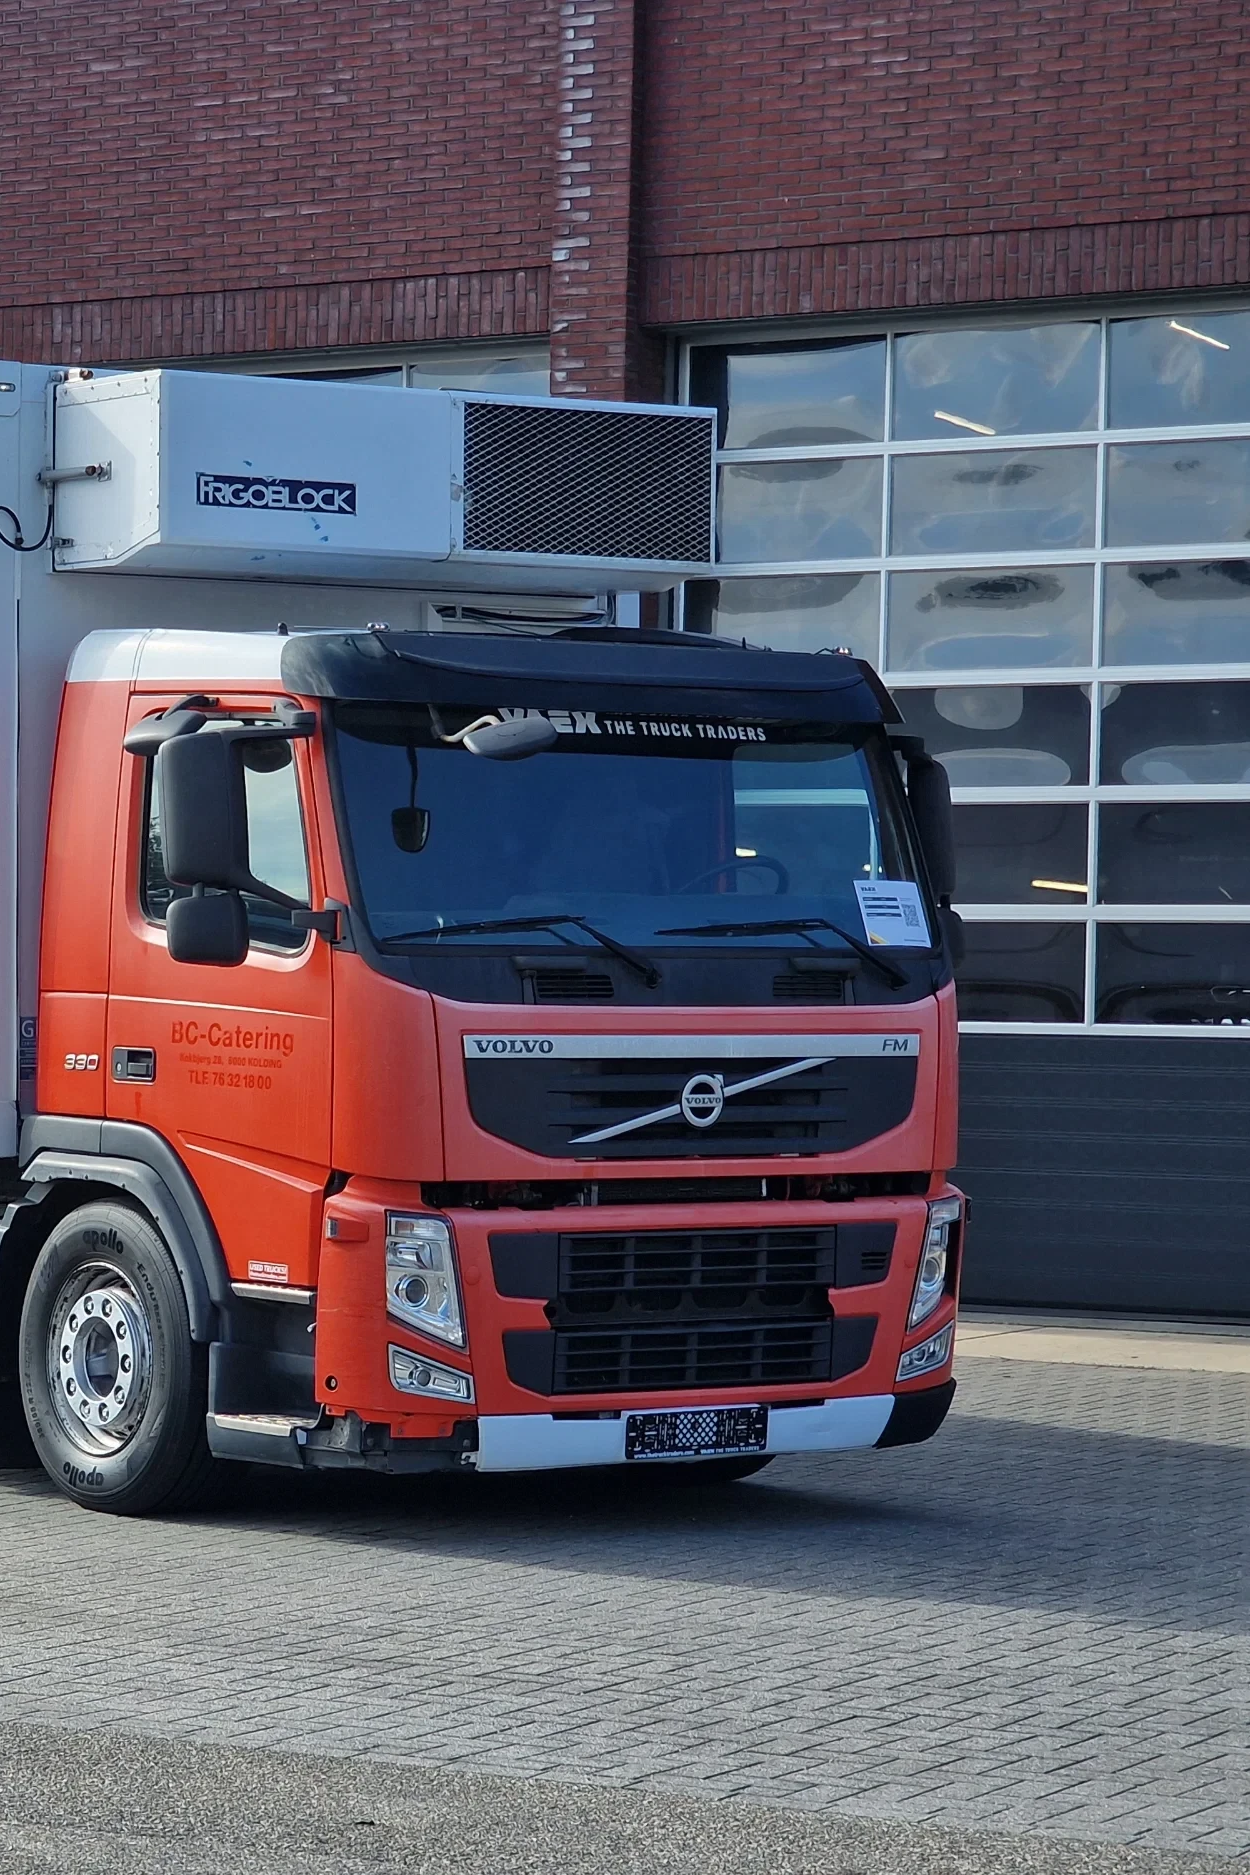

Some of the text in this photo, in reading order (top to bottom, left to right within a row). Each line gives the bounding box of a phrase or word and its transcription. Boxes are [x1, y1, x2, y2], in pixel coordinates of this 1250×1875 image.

[199, 476, 354, 512] FRIGOBLOCK
[604, 719, 635, 735] THE
[640, 721, 693, 738] TRUCK
[696, 724, 767, 742] TRADERS
[171, 1021, 294, 1057] BC-Catering
[473, 1039, 554, 1053] VOLVO
[882, 1038, 909, 1051] FM
[64, 1053, 99, 1070] 330
[247, 1057, 282, 1069] KOLDING
[212, 1071, 225, 1087] 76
[227, 1073, 241, 1088] 32
[243, 1074, 255, 1089] 18
[257, 1075, 272, 1090] 00
[685, 1097, 721, 1105] VOLVO
[82, 1228, 124, 1254] apollo
[63, 1461, 104, 1487] apollo
